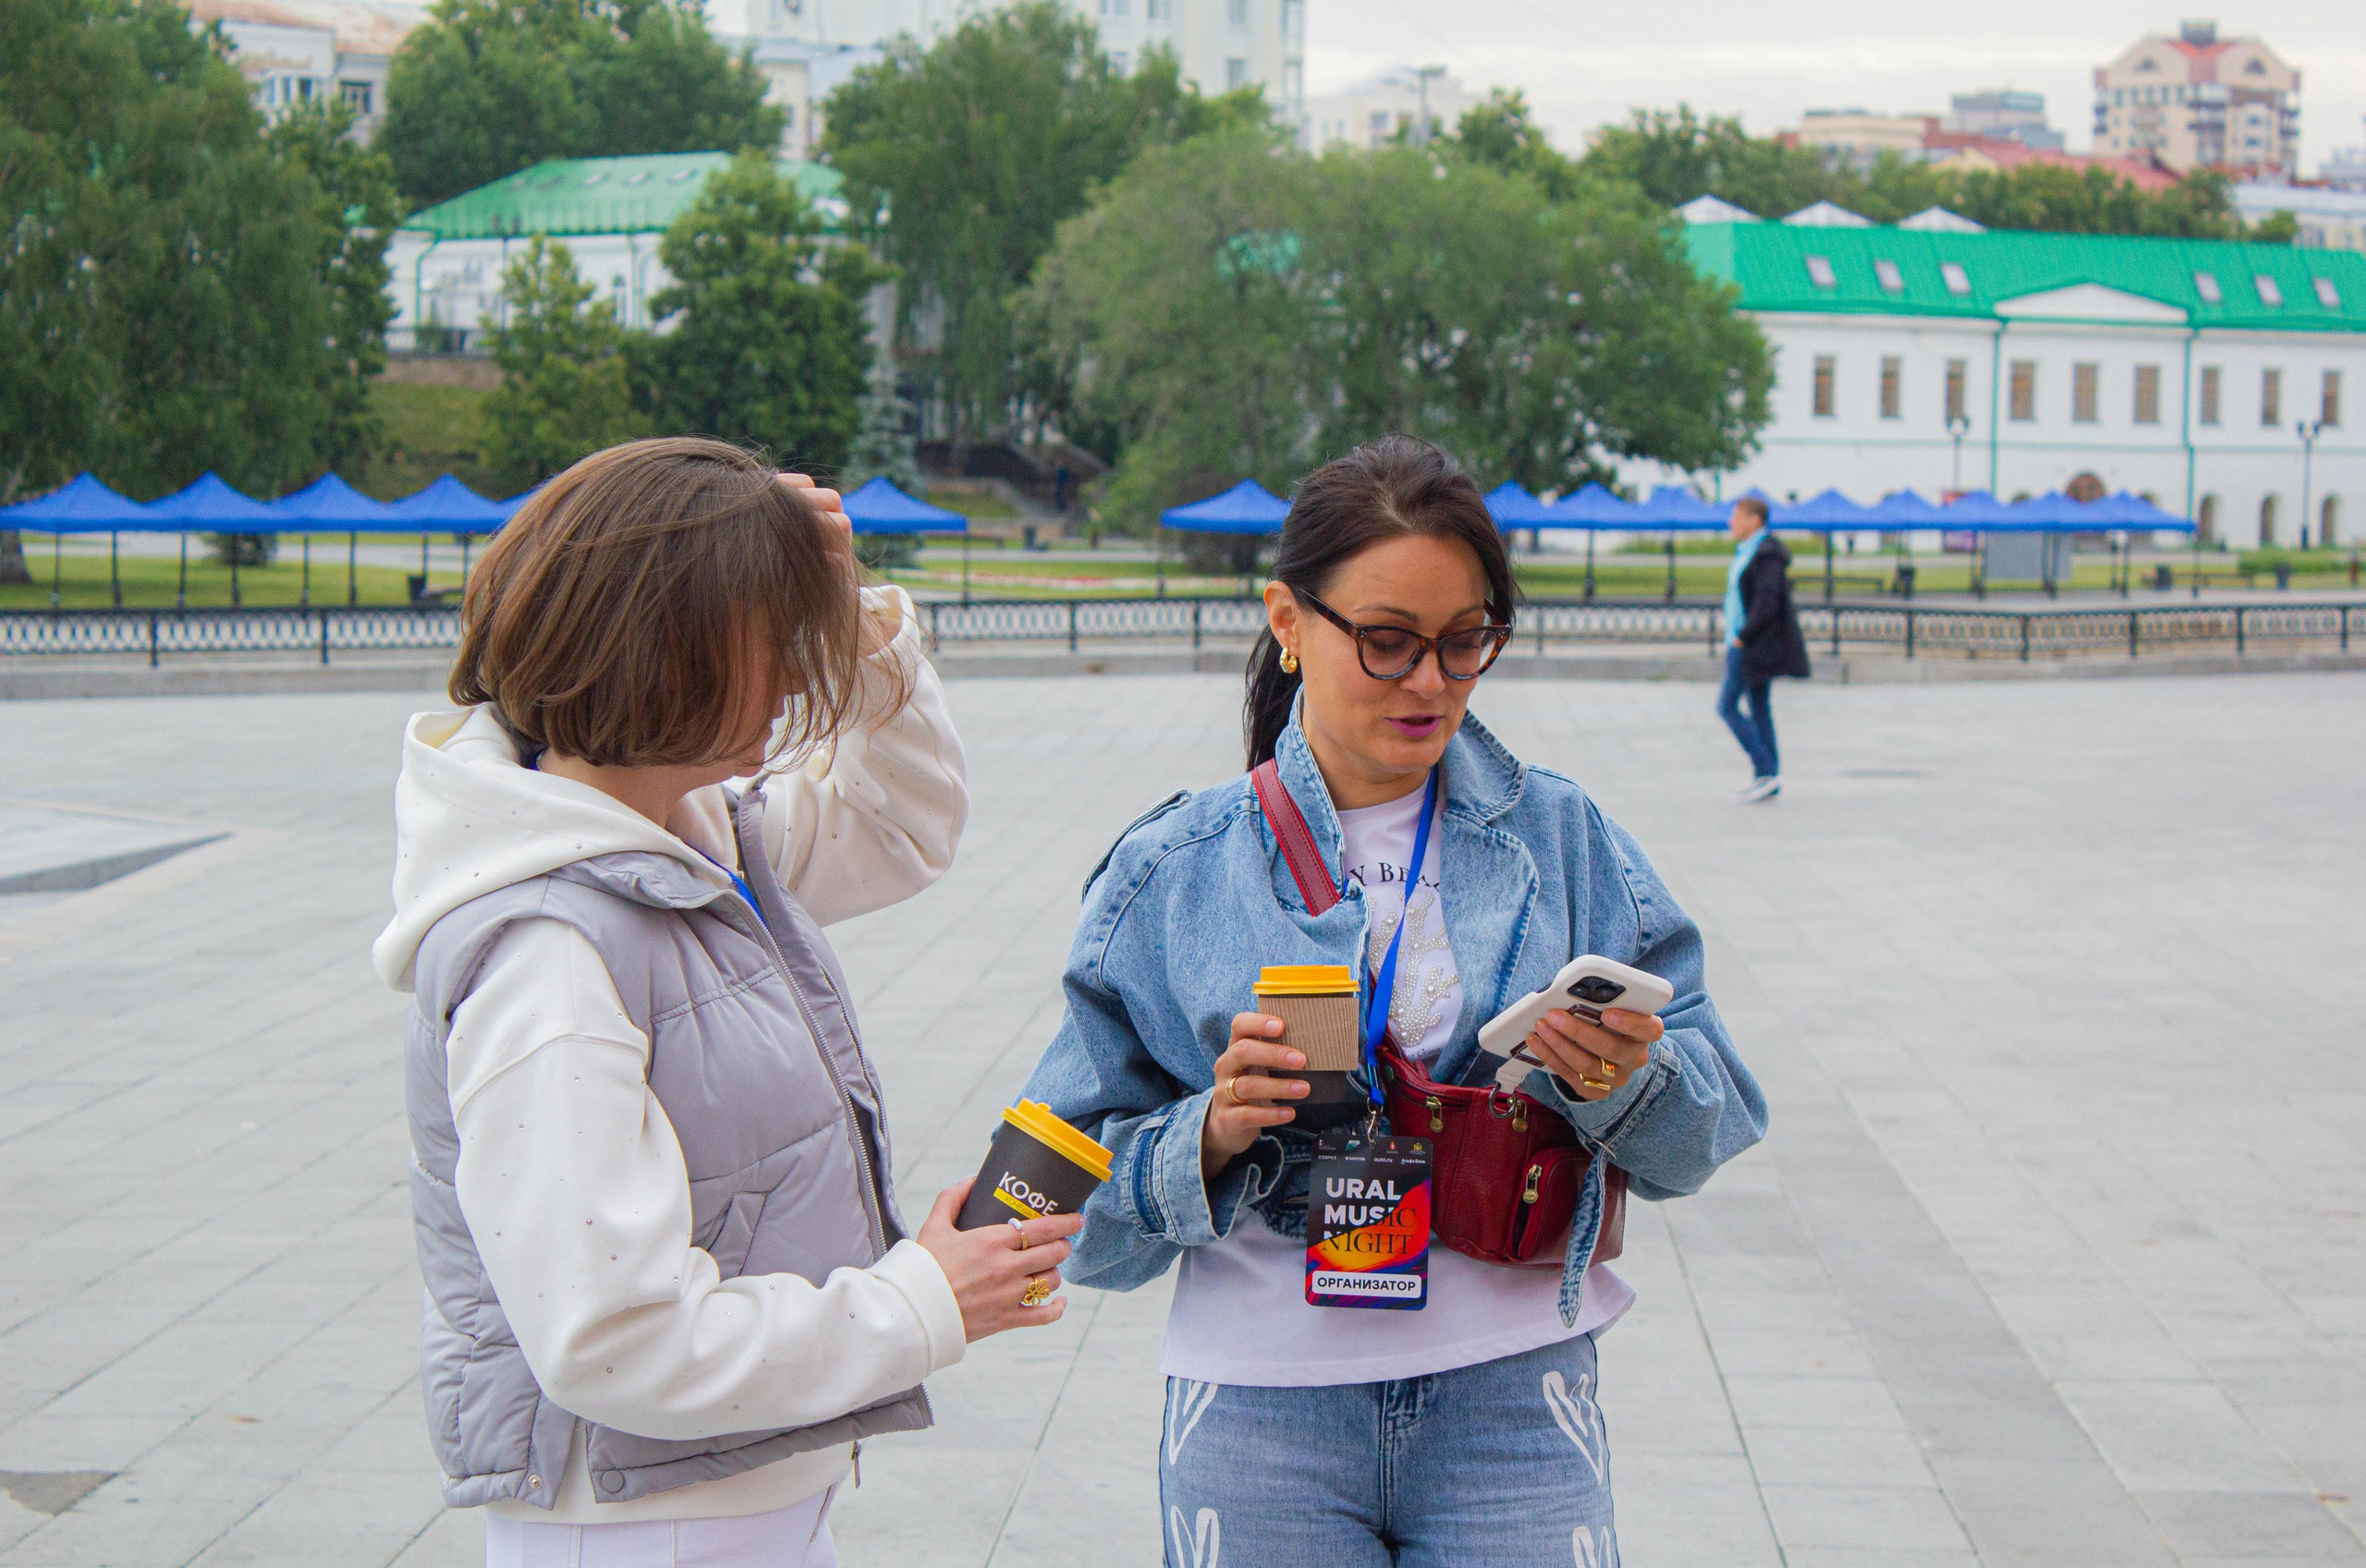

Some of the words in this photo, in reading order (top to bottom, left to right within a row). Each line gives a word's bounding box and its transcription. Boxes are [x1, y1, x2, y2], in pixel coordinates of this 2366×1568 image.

[998, 1171, 1058, 1216] КОФЕ
[1325, 1177, 1402, 1200] URAL
[1004, 1196, 1038, 1219] ХОЧЕШЬ?
[1323, 1204, 1416, 1228] MUSIC
[1322, 1231, 1414, 1255] NIGHT
[1317, 1277, 1416, 1291] ОРГАНИЗАТОР
